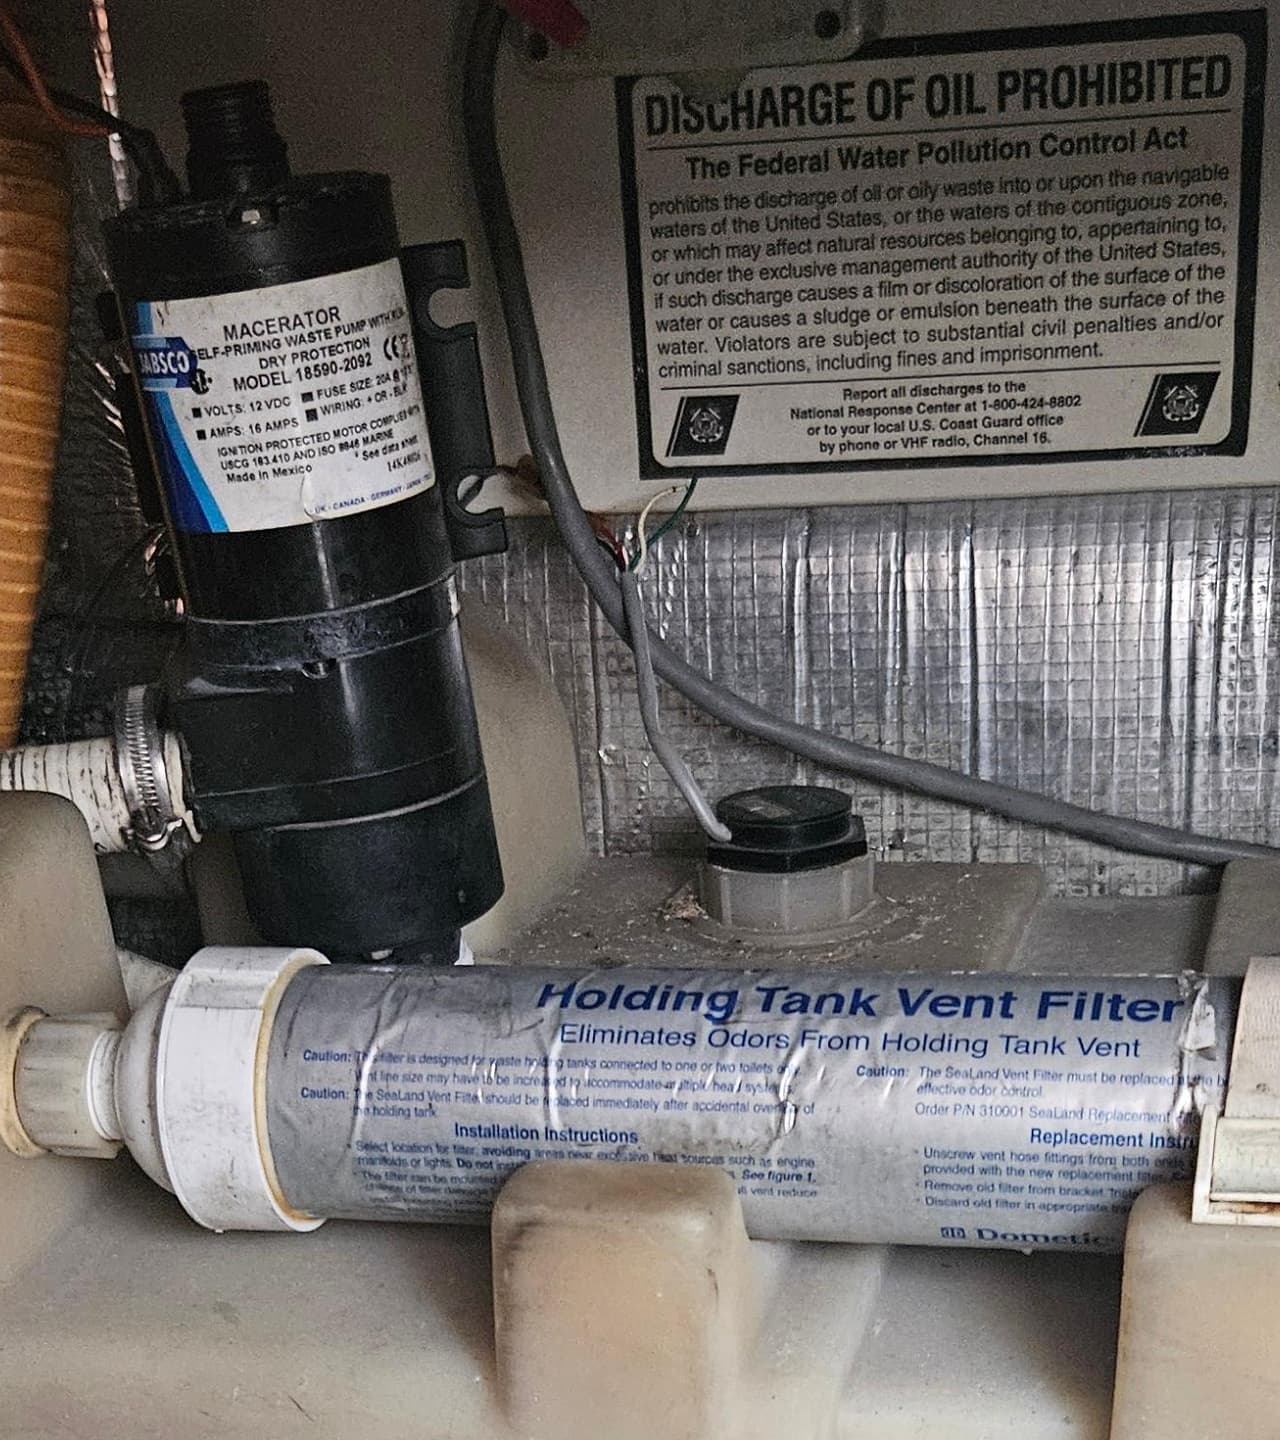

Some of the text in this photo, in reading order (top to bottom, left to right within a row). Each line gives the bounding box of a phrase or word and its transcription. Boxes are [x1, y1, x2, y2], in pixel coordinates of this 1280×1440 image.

[646, 54, 1232, 136] DISCHARGE OF OIL PROHIBITED
[686, 126, 1187, 180] The Federal Water Pollution Control Act
[652, 238, 1226, 288] or under the exclusive management authority of the United States,
[655, 286, 1225, 333] water or causes a sludge or emulsion beneath the surface of the
[223, 306, 341, 342] MACERATOR
[656, 311, 1224, 356] water. Violators are subject to substantial civil penalties and/or
[192, 338, 282, 361] SELF-PRIMING
[284, 328, 333, 348] WASTE
[335, 319, 367, 337] PUMP
[139, 351, 190, 375] JABSCO
[259, 337, 370, 370] DRY PROTECTION
[658, 341, 1103, 378] criminal sanctions, including fines and imprisonment.
[233, 371, 292, 392] MODEL
[296, 352, 373, 382] 18590-2092
[250, 400, 262, 413] 12
[265, 396, 292, 410] VDC
[317, 383, 347, 400] FUSE
[842, 379, 1027, 405] Report all discharges to the
[789, 394, 1082, 422] National Response Center at 1-800-424-8802
[249, 422, 262, 435] 16
[265, 417, 300, 433] AMPS
[806, 412, 1064, 439] or to your local U.S. Coast Guard office
[218, 422, 368, 458] IGNITION PROTECTED MOTOR
[221, 460, 250, 470] USCG
[293, 449, 316, 462] AND
[319, 444, 336, 457] ISO
[362, 428, 394, 446] MARINE
[819, 431, 1051, 457] by phone or VHF radio, Channel 16.
[226, 472, 256, 484] Made
[272, 464, 313, 478] Mexico
[333, 496, 366, 511] CANADA
[537, 983, 1185, 1025] Holding Tank Vent Filter
[560, 1023, 1141, 1059] Eliminates Odors From Holding Tank Vent
[303, 1049, 352, 1063] Caution:
[856, 1064, 910, 1078] Caution:
[920, 1065, 942, 1079] The
[945, 1066, 999, 1080] SeaLand
[1002, 1067, 1030, 1080] Vent
[1033, 1069, 1063, 1083] Filter
[1066, 1071, 1098, 1084] must
[1101, 1071, 1116, 1084] be
[1120, 1072, 1174, 1087] replaced
[301, 1087, 350, 1100] Caution:
[915, 1103, 1171, 1124] Order P/N 310001 SeaLand Replacement
[455, 1122, 638, 1144] Installation Instructions
[1030, 1128, 1144, 1148] Replacement
[924, 1147, 1150, 1168] Unscrew vent hose fittings from both
[742, 1169, 765, 1181] See
[767, 1170, 803, 1184] figure
